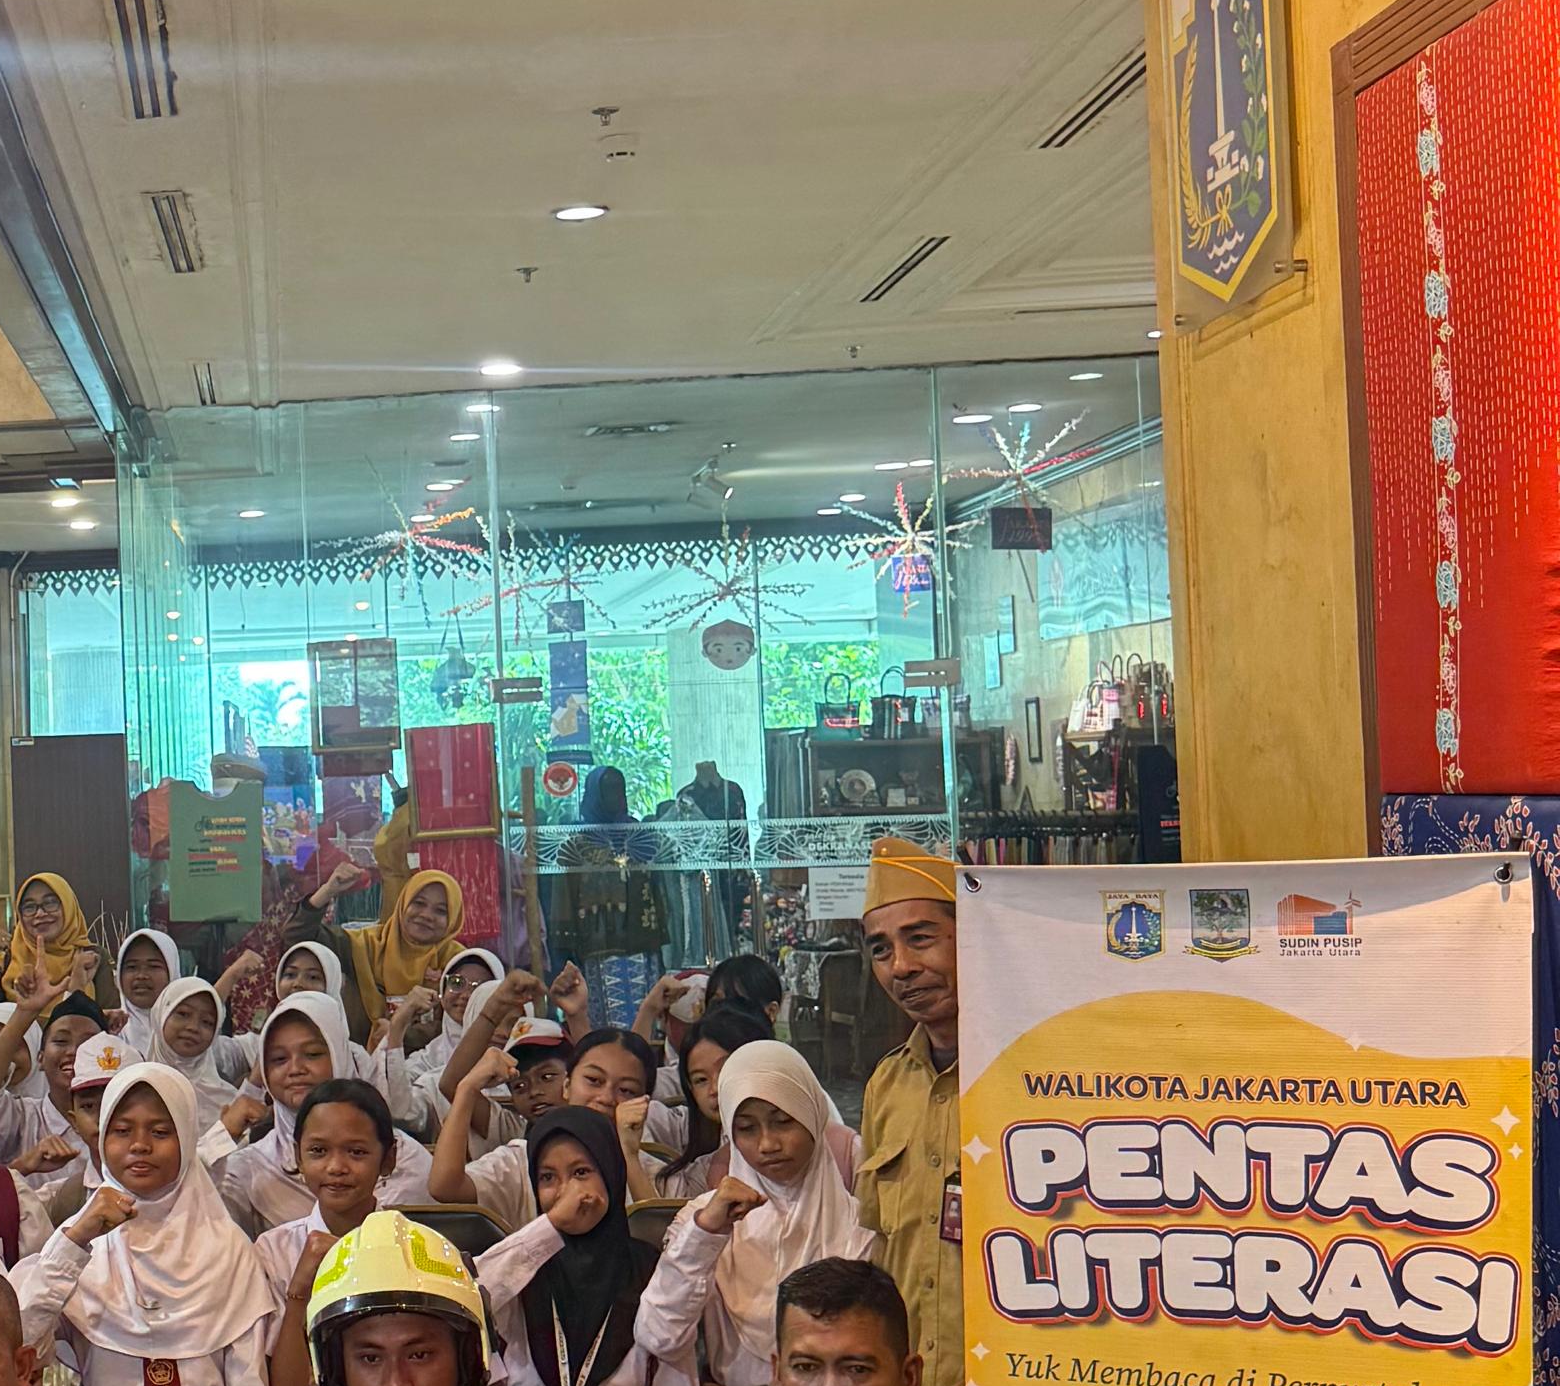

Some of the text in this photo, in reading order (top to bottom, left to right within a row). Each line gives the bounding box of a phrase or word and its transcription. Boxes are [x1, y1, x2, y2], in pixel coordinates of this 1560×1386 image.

[1279, 937, 1363, 948] SUDIN PUSIP
[1279, 948, 1361, 957] Jakarta Utara
[1024, 1073, 1468, 1108] WALIKOTA JAKARTA UTARA
[1004, 1119, 1499, 1231] PENTAS
[985, 1229, 1519, 1353] LITERASI
[1005, 1352, 1060, 1382] Yuk
